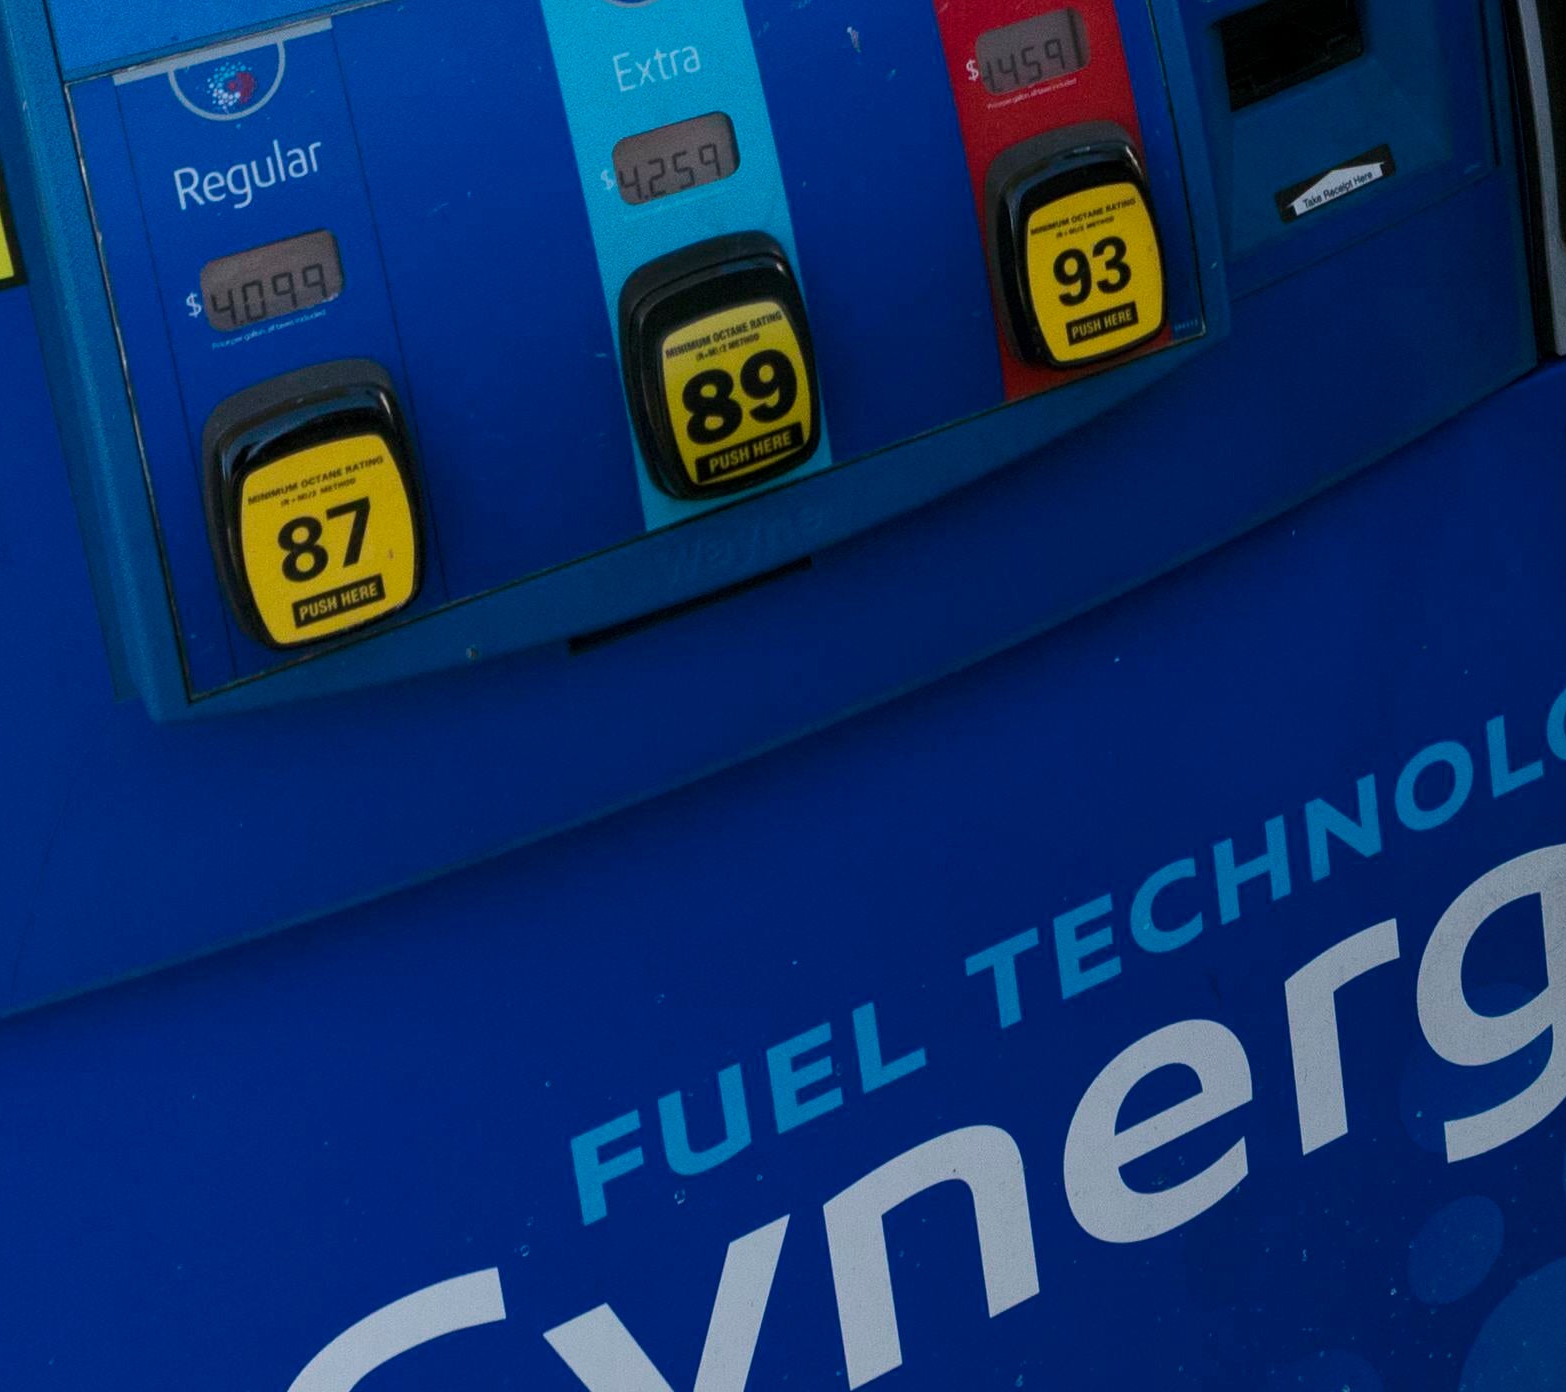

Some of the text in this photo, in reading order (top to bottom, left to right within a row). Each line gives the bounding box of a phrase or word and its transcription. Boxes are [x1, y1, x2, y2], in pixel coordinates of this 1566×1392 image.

[614, 40, 701, 92] Extra
[174, 137, 323, 213] Regular
[1303, 170, 1373, 208] Take Receipt Here
[1053, 236, 1132, 307] 93
[1071, 308, 1133, 340] PUSH HERE
[681, 348, 798, 445] 89
[708, 430, 794, 476] PUSH HERE
[277, 497, 373, 583] 87
[299, 581, 379, 621] PUSH HERE
[569, 1000, 926, 1226] FUEL
